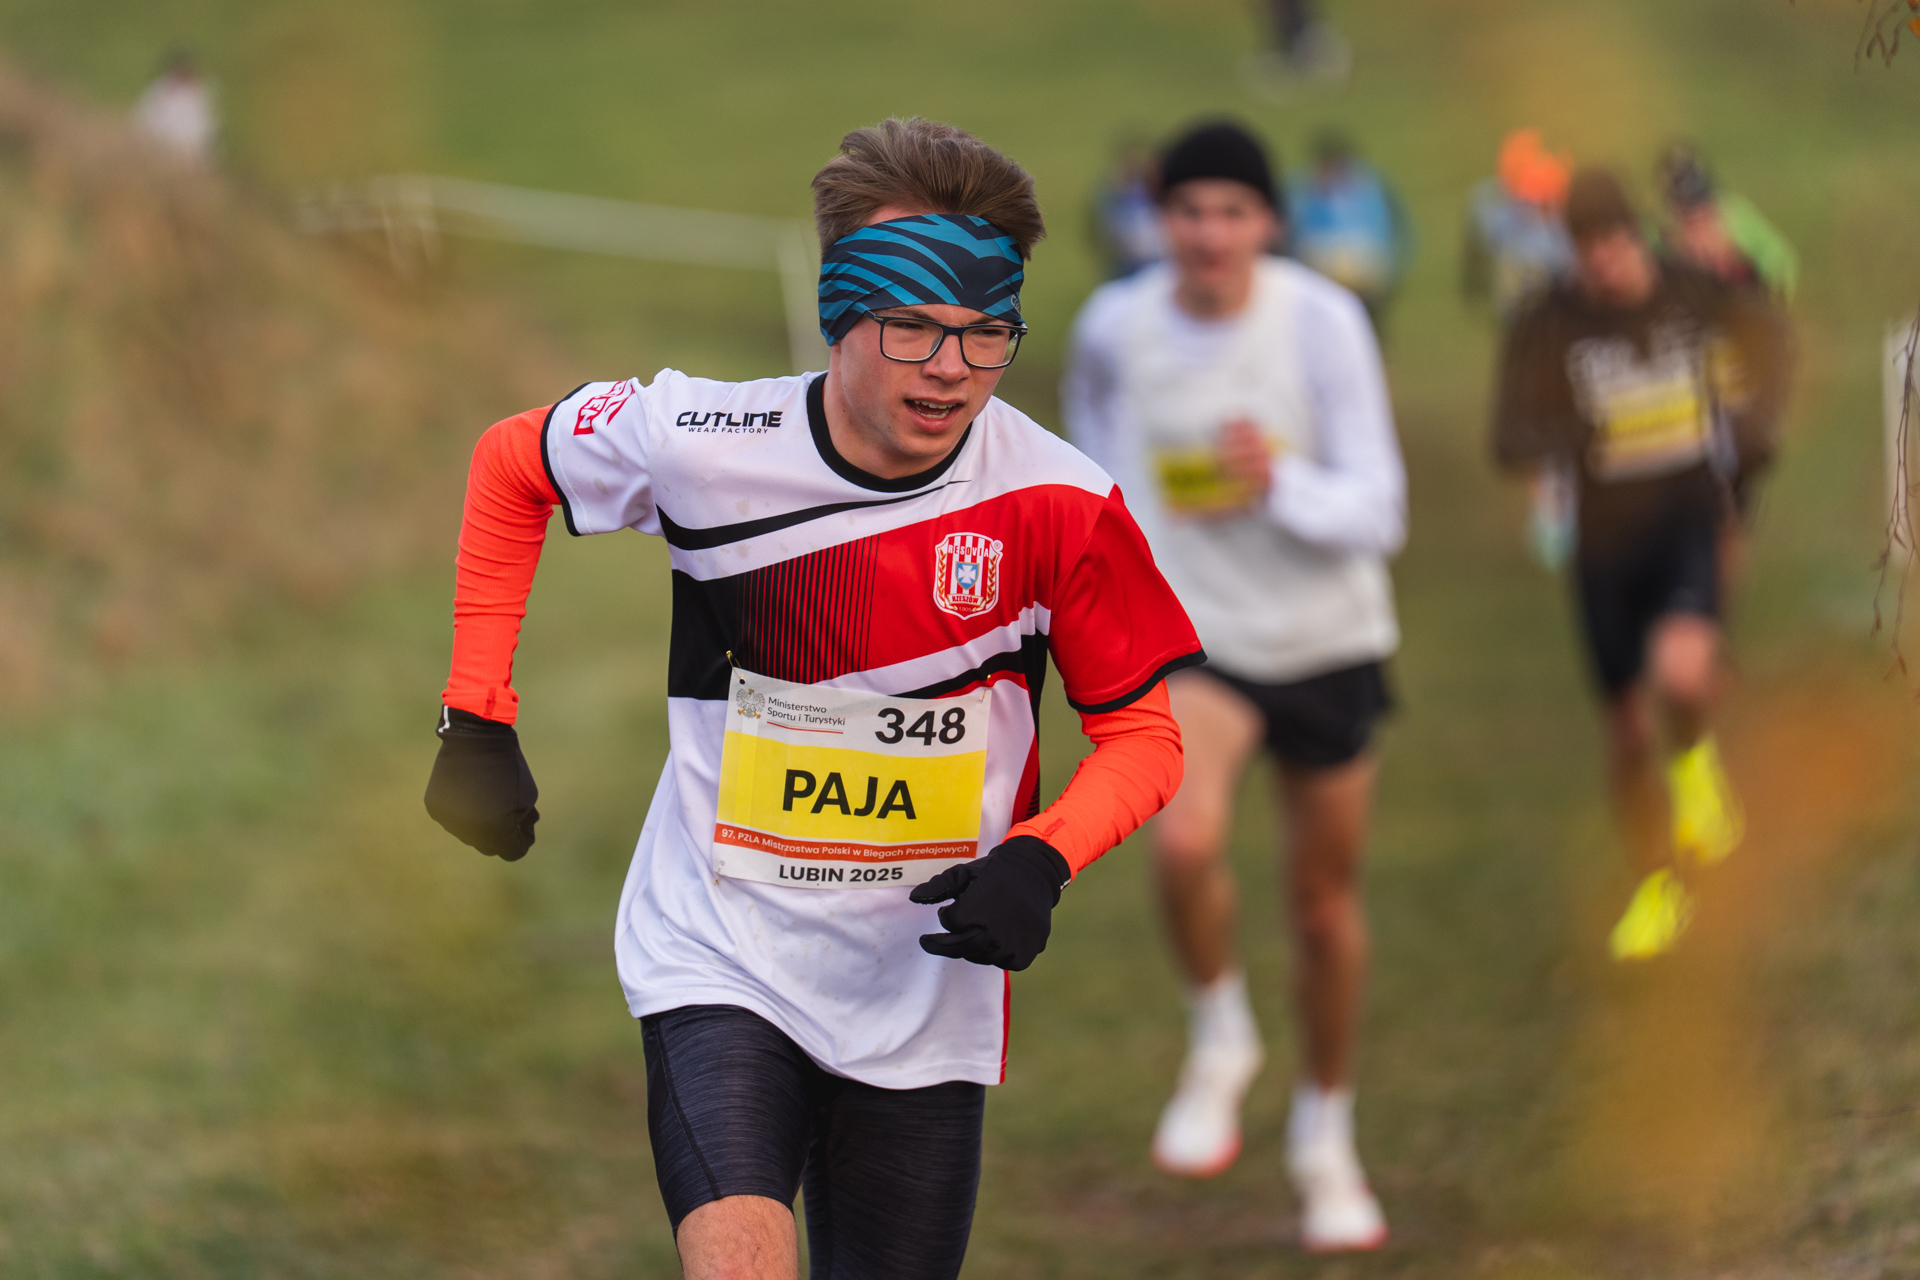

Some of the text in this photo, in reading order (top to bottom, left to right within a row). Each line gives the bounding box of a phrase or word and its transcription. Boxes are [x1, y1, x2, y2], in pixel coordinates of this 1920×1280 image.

[676, 411, 783, 427] CUTLINE
[948, 544, 989, 557] RESOVIA
[768, 696, 827, 713] Ministerstwo
[767, 706, 796, 721] Sportu
[804, 713, 846, 726] Turystyki
[874, 707, 966, 746] 348
[782, 768, 917, 820] PAJA
[721, 828, 736, 839] 97.
[737, 832, 760, 844] PZLA
[762, 838, 820, 854] Mistrzostwa
[821, 846, 851, 855] Polski
[863, 848, 904, 860] Biegach
[905, 845, 970, 856] Przełajowych
[779, 864, 904, 882] LUBIN 2025
